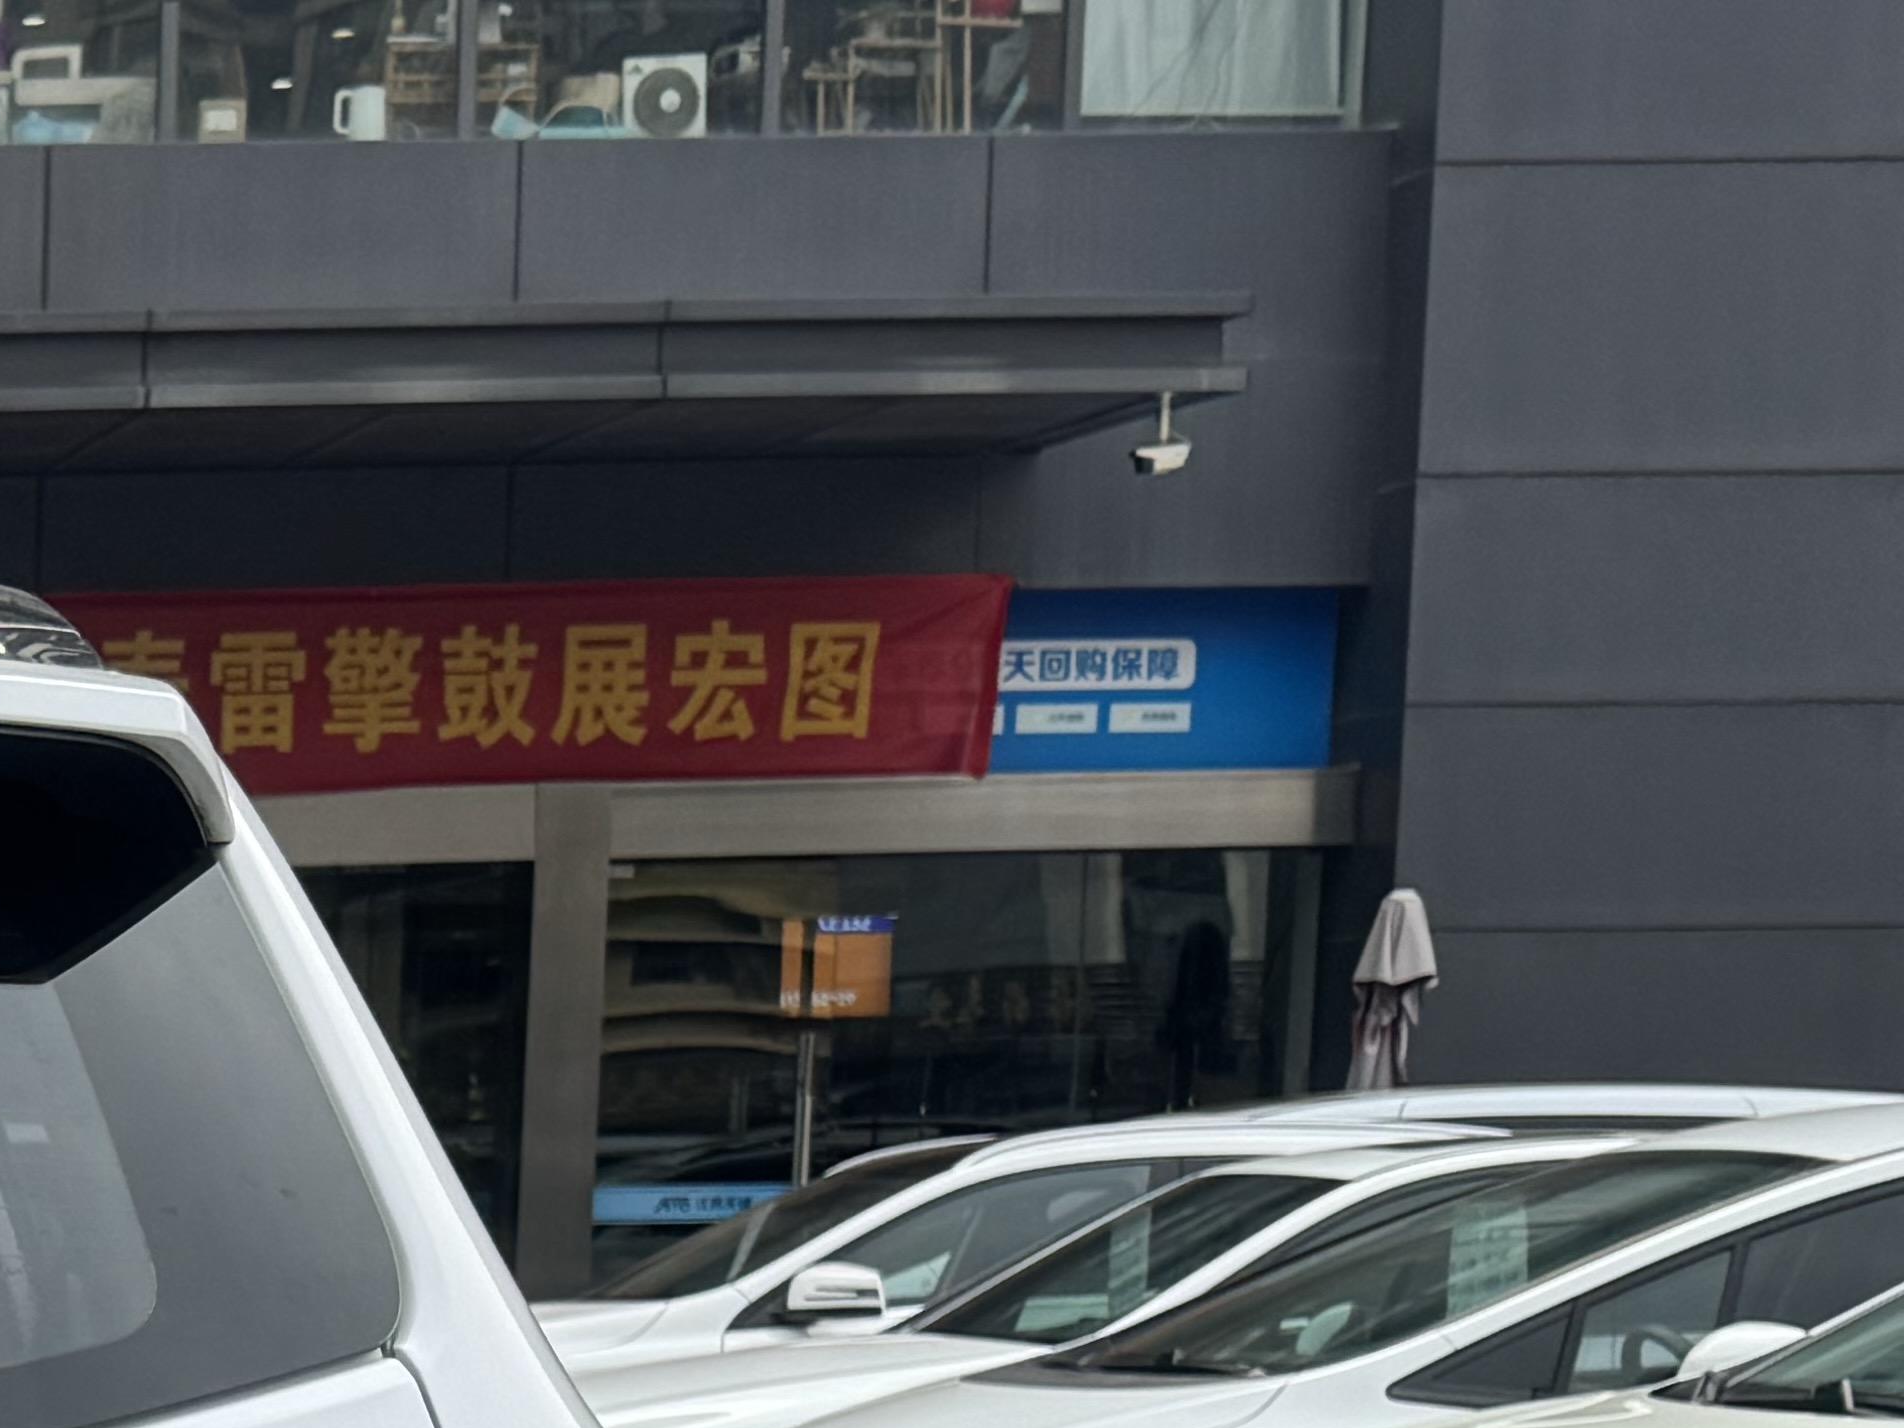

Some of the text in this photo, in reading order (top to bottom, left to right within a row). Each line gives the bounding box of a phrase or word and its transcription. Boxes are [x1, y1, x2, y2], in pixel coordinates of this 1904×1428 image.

[1001, 647, 1182, 683] 天回购保障
